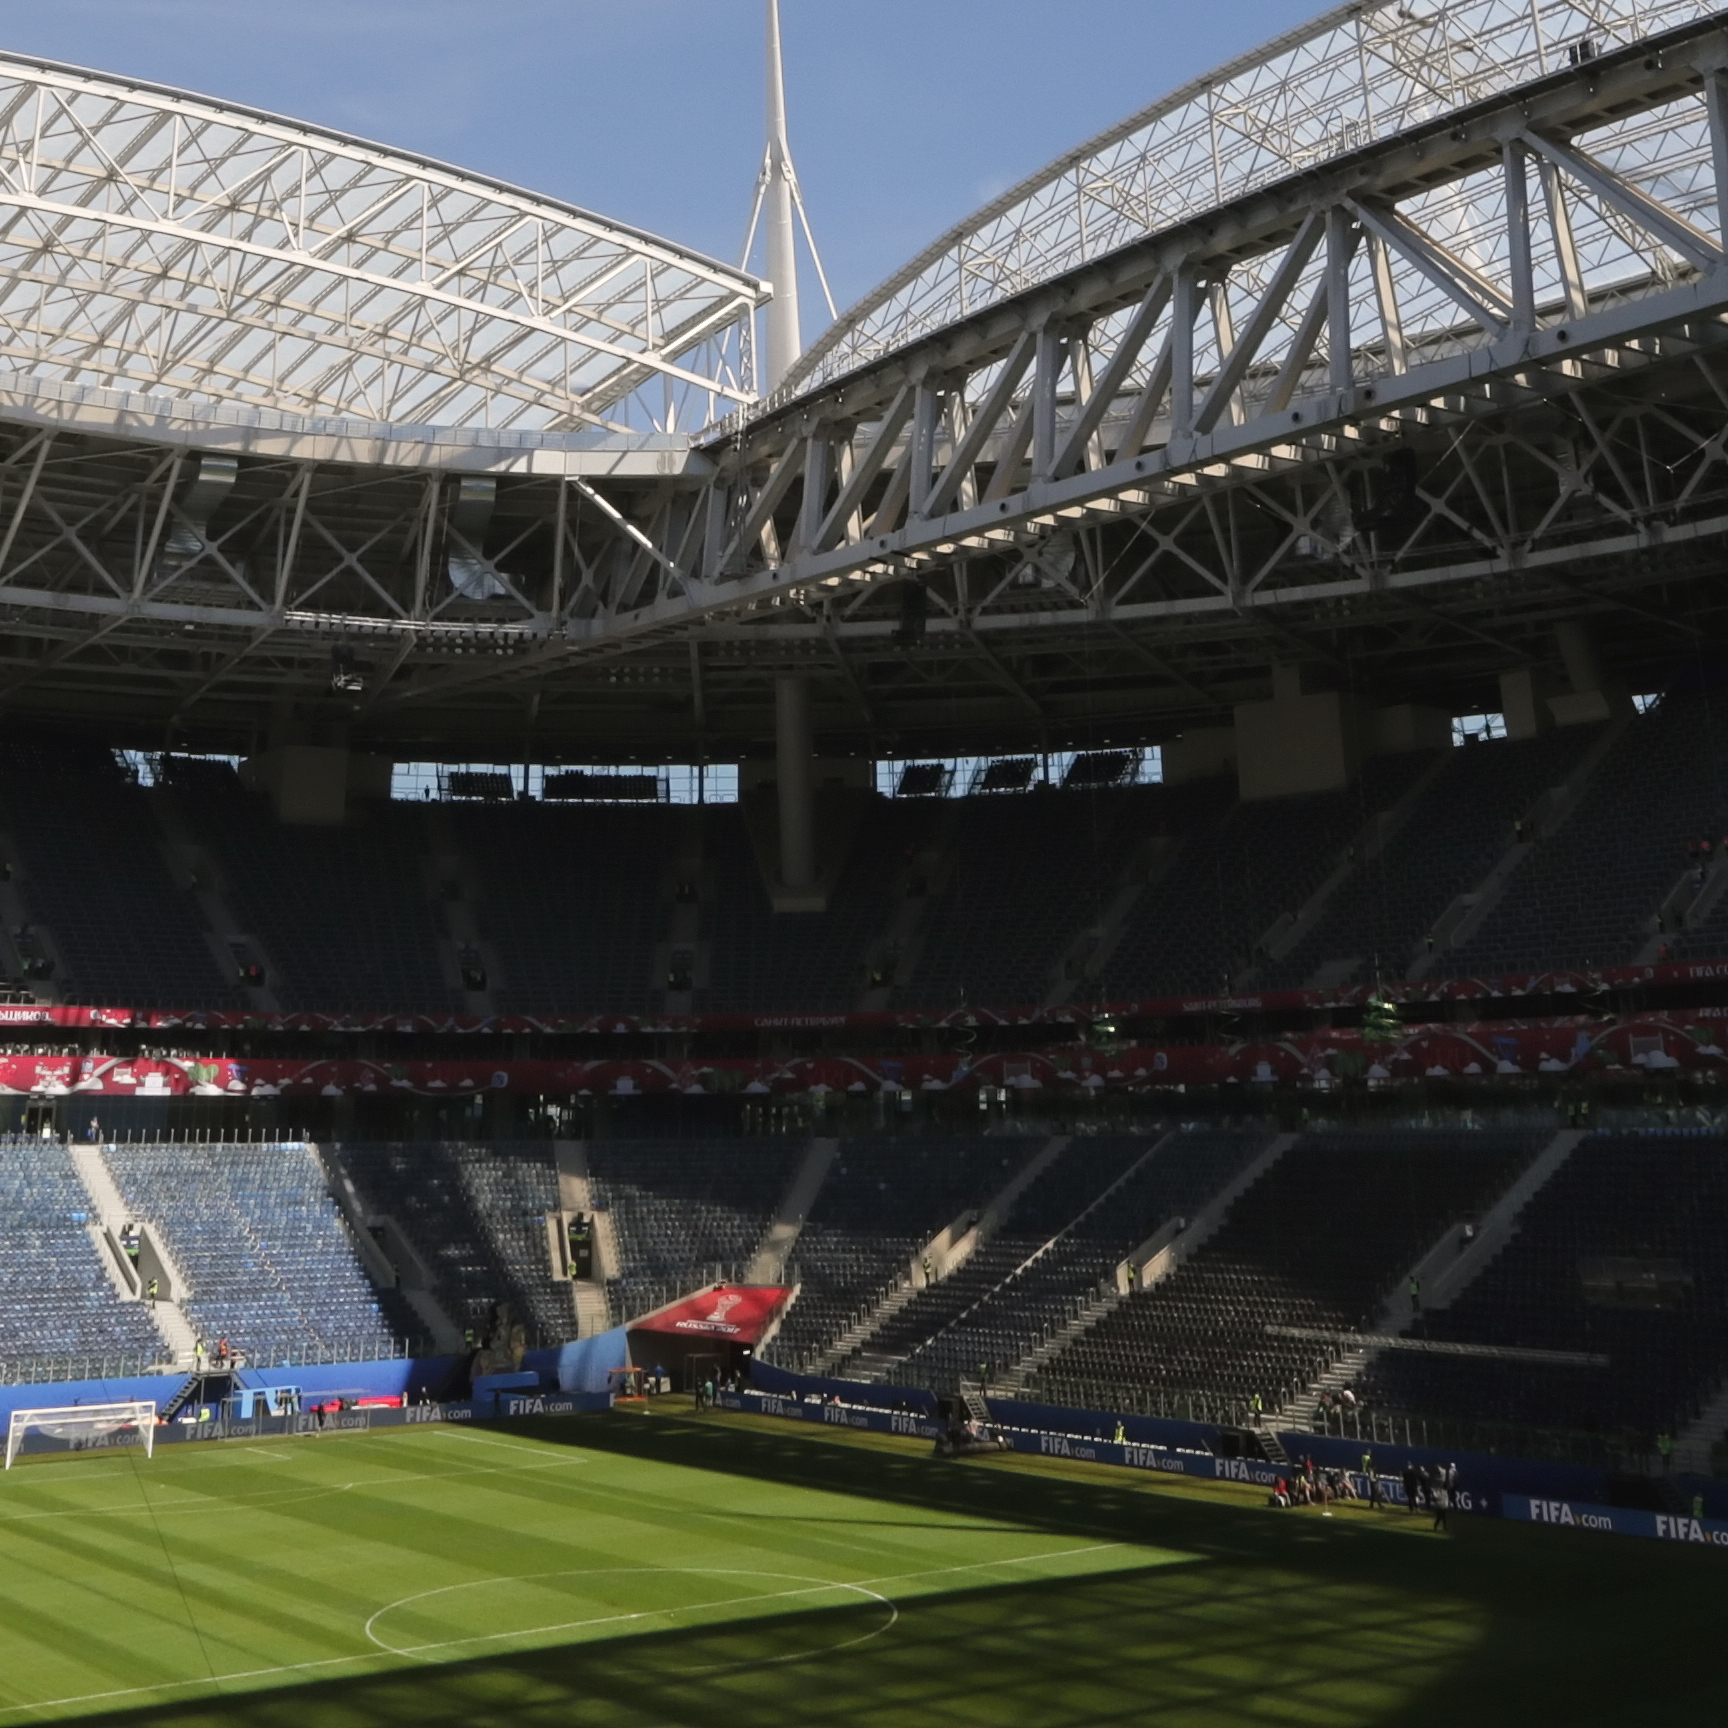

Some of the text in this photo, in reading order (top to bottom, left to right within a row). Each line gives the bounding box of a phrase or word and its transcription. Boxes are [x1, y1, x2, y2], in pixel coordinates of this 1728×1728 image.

[1689, 966, 1714, 978] FIFA
[406, 1406, 472, 1422] FIFA.com
[509, 1398, 573, 1415] FIFA.com
[1041, 1435, 1096, 1460] FIFA.com
[1124, 1447, 1184, 1472] FIFA.com
[1529, 1499, 1612, 1530] FIFA.com
